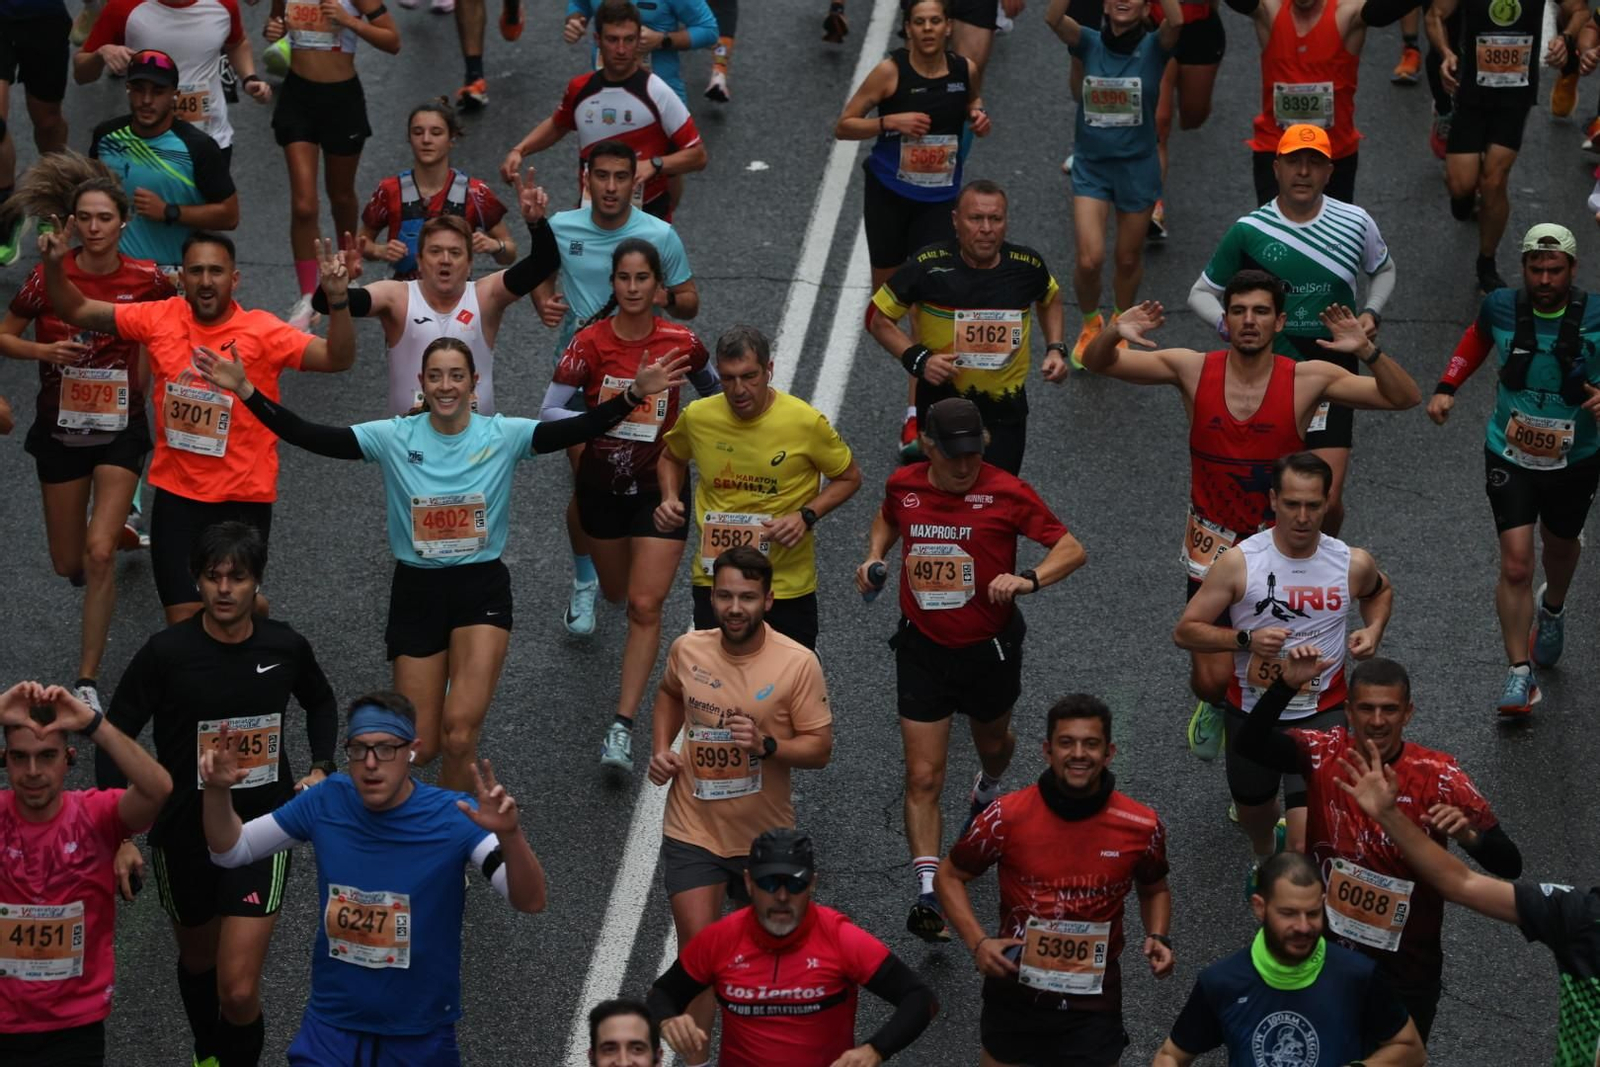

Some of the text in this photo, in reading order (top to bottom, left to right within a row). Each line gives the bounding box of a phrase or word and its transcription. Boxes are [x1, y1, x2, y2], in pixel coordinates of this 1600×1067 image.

[1484, 48, 1520, 65] 3898
[1281, 96, 1320, 112] 8392
[965, 325, 1007, 345] 5162
[70, 383, 113, 404] 5979
[170, 401, 213, 426] 3701
[714, 477, 779, 496] SEVILLA
[423, 509, 469, 530] 4602
[711, 527, 755, 547] 5582
[910, 524, 972, 541] MAXPROG.PT
[1191, 527, 1214, 554] 99
[913, 561, 956, 581] 4973
[689, 696, 721, 714] Maratón
[696, 746, 742, 769] 5993
[1337, 881, 1390, 916] 6088
[337, 906, 388, 933] 6247
[9, 924, 65, 947] 4151
[1036, 936, 1089, 961] 5396
[725, 983, 754, 999] Los
[728, 1003, 752, 1015] CLUB
